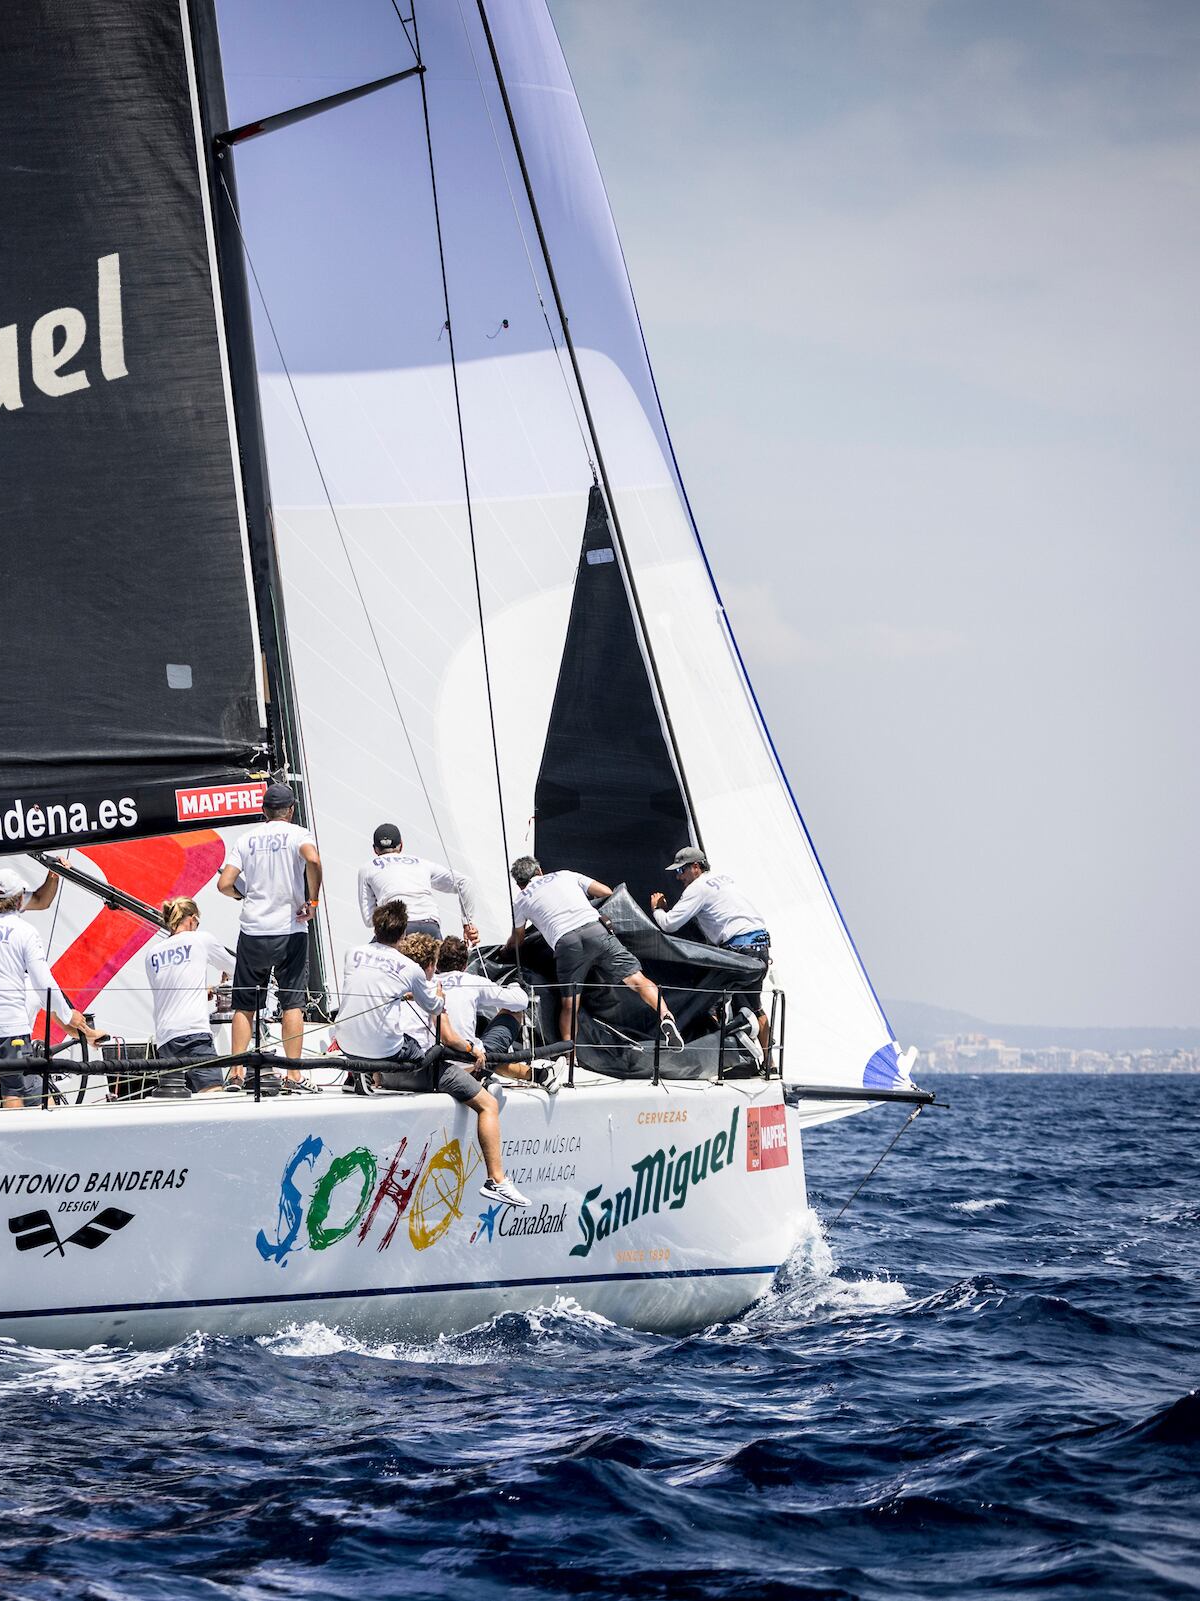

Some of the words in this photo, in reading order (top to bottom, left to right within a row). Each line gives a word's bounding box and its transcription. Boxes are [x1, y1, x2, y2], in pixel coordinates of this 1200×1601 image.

[181, 789, 264, 815] MAPFRE
[248, 833, 289, 856] GYPSY
[151, 944, 193, 974] GYPSY
[636, 1110, 688, 1125] CERVEZAS
[501, 1140, 541, 1157] TEATRO
[543, 1135, 582, 1154] MÚSICA
[761, 1124, 787, 1150] MAPFRE
[84, 1168, 189, 1193] BANDERAS
[503, 1168, 533, 1183] ANZA
[536, 1163, 576, 1182] MÁLAGA
[57, 1201, 100, 1213] DESIGN
[498, 1202, 568, 1237] CaixaBank
